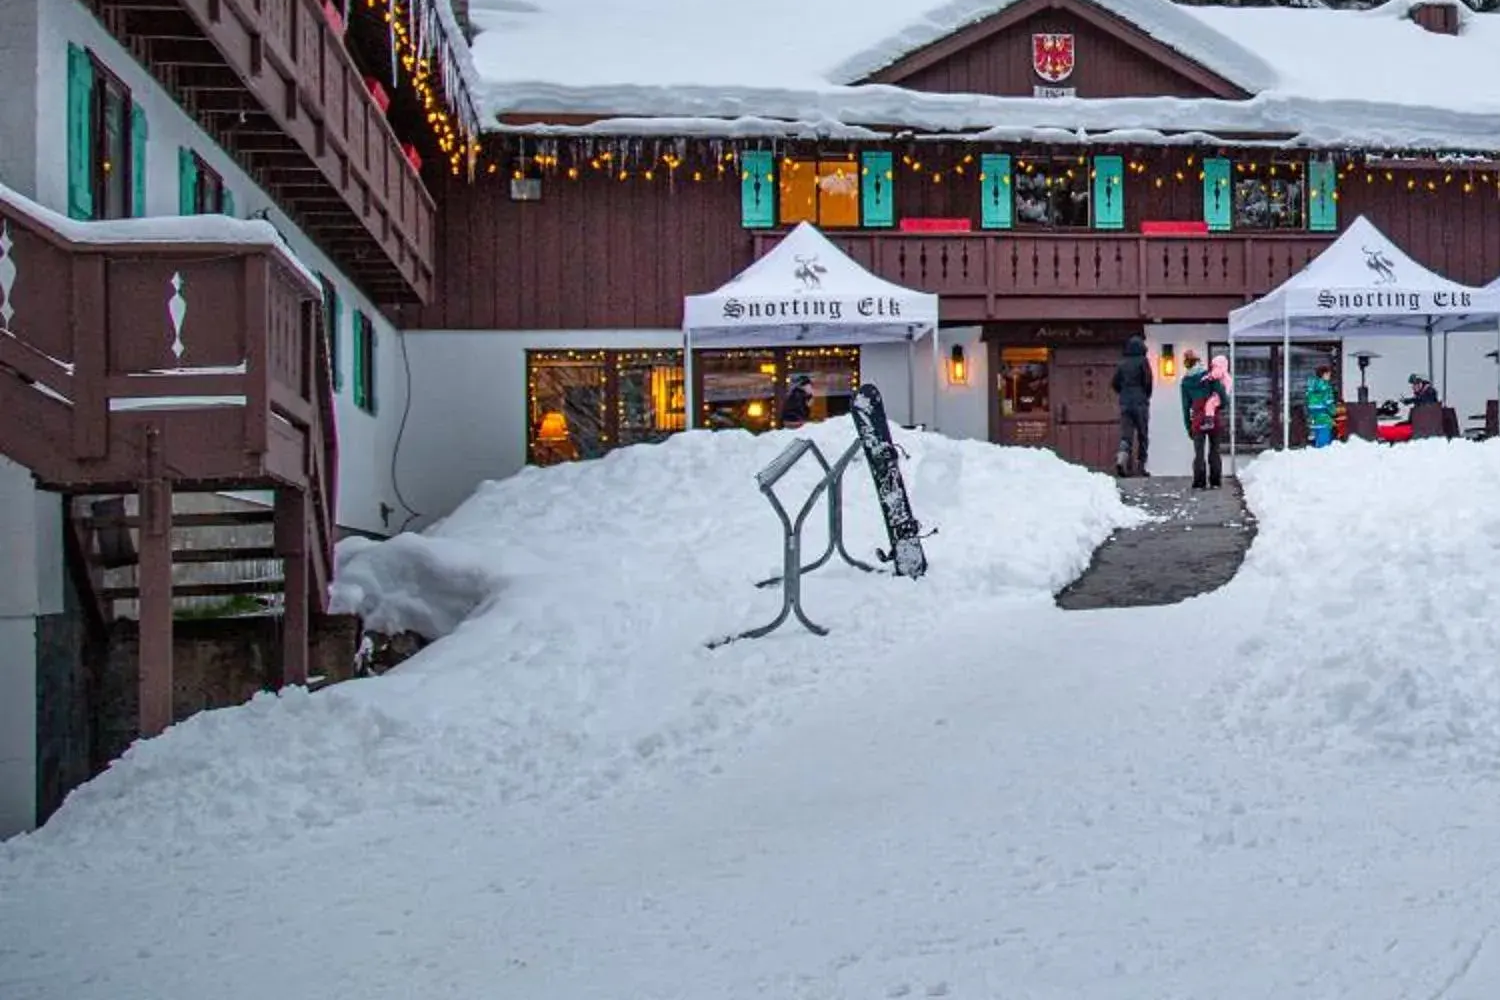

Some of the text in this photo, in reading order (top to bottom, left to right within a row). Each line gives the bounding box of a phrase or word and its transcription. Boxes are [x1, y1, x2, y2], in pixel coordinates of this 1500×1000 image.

[723, 297, 902, 319] Snorting Elk
[1317, 289, 1472, 310] Snorting Elk
